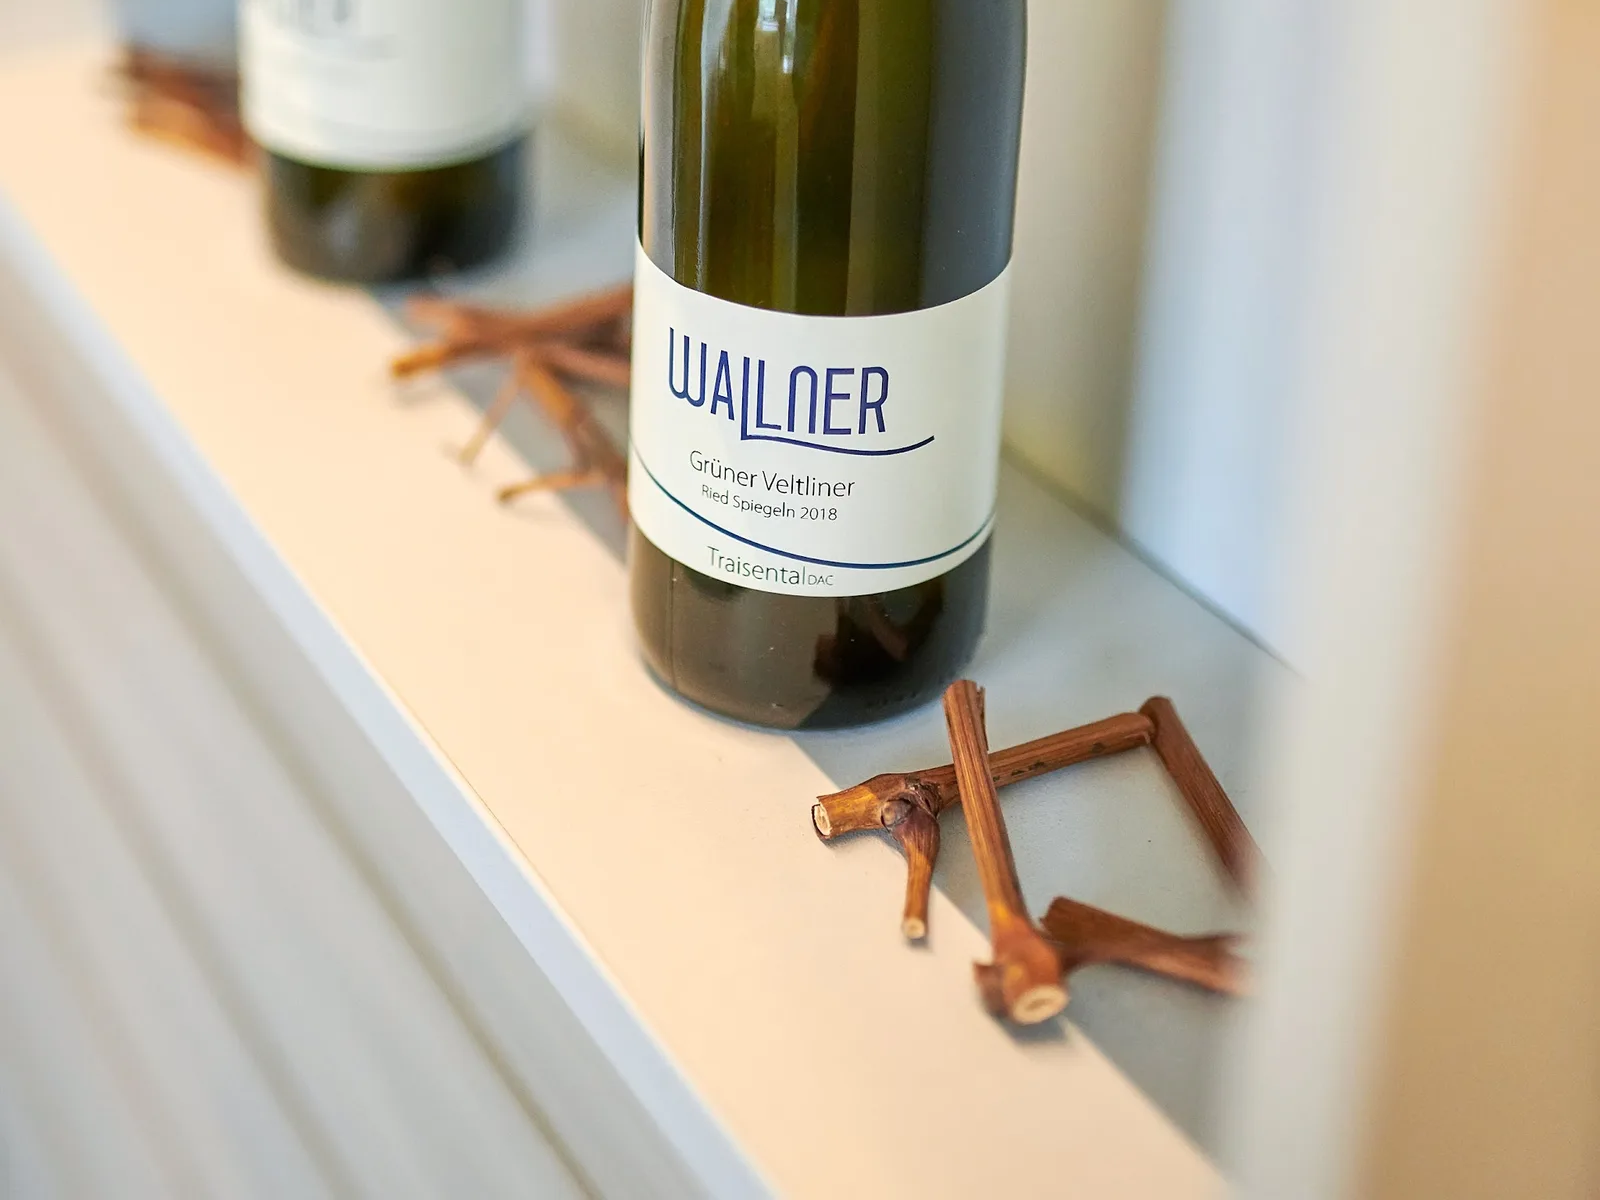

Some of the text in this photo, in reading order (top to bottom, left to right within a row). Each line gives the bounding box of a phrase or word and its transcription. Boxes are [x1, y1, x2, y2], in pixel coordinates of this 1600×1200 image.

[667, 327, 935, 457] WALLNER
[689, 450, 856, 497] Grüner Veltliner
[702, 484, 838, 520] Ried Spiegeln 2018
[707, 546, 834, 586] Traisental DAC
